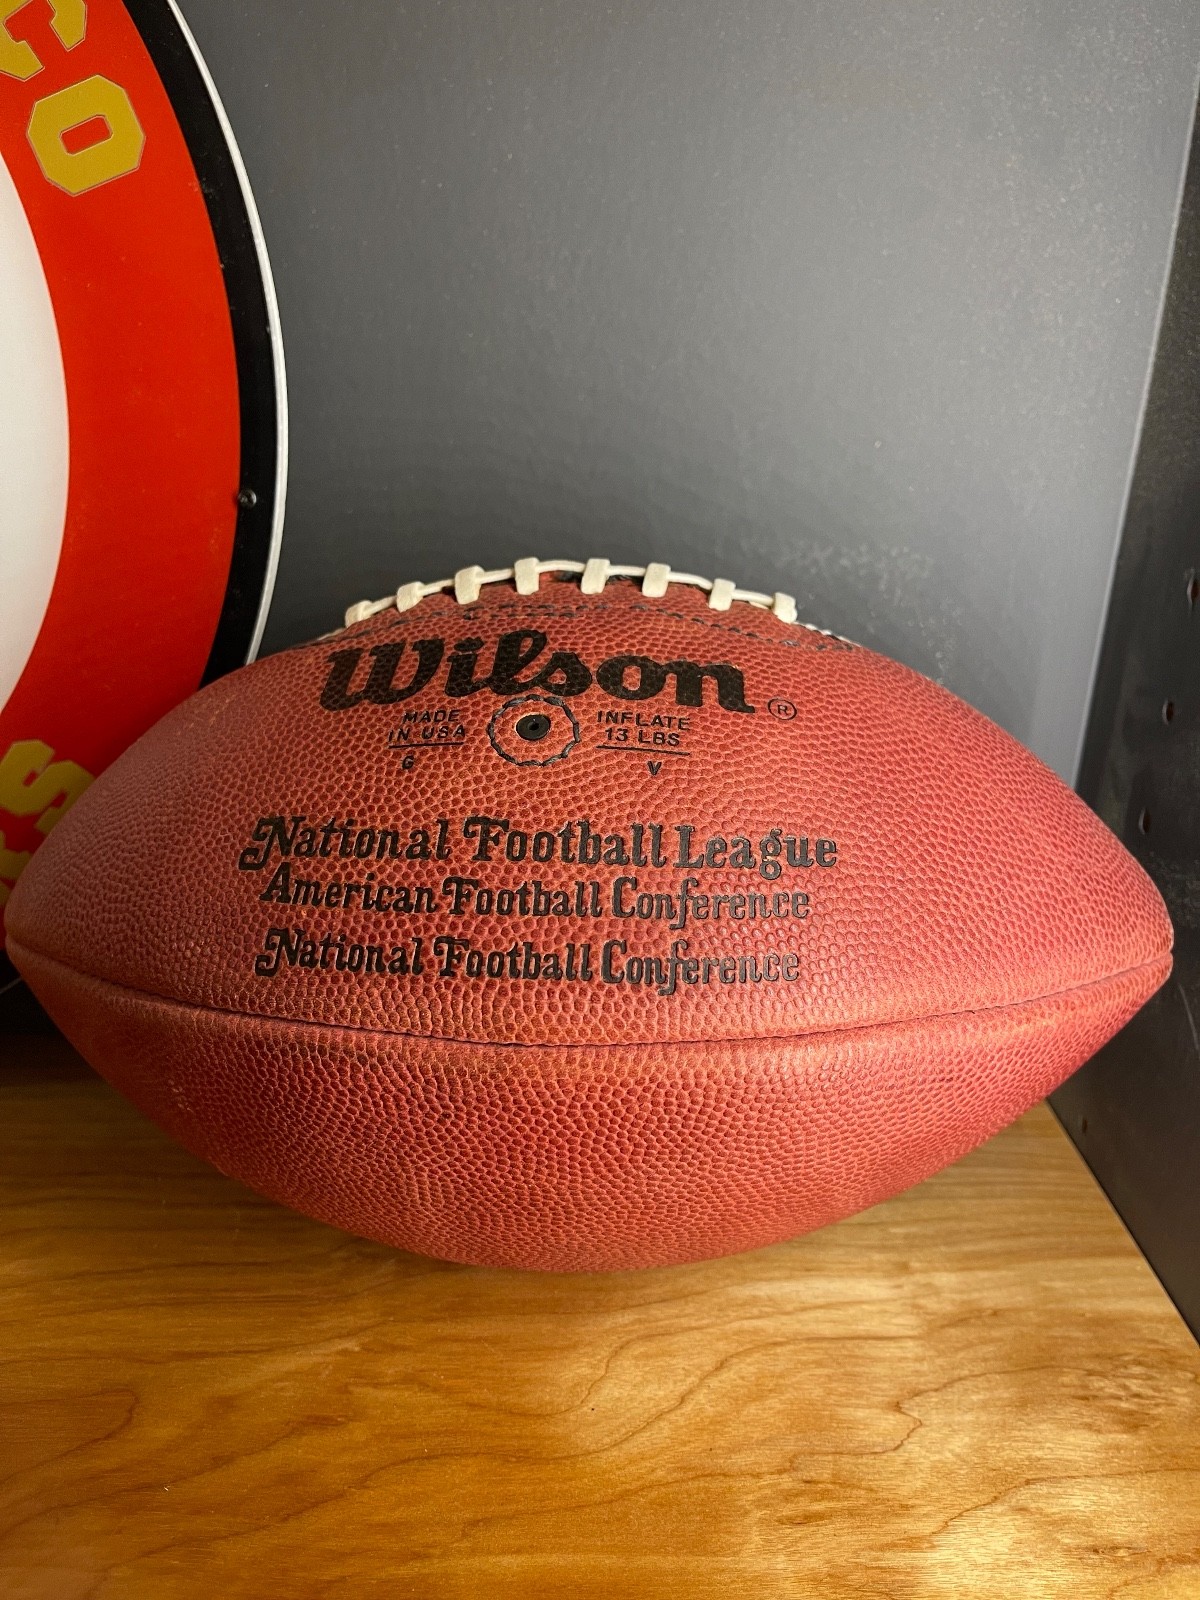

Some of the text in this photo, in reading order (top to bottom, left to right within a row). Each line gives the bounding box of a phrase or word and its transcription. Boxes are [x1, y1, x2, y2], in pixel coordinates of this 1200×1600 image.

[318, 629, 755, 713] Wilson
[402, 709, 461, 724] MADE
[597, 710, 690, 731] INFLATE
[388, 724, 466, 742] IN USA
[605, 728, 680, 746] 13 LBS
[647, 760, 662, 776] V
[239, 815, 837, 880] National Football League
[260, 862, 809, 930] American Football Conference
[254, 927, 800, 996] National Football Conference
